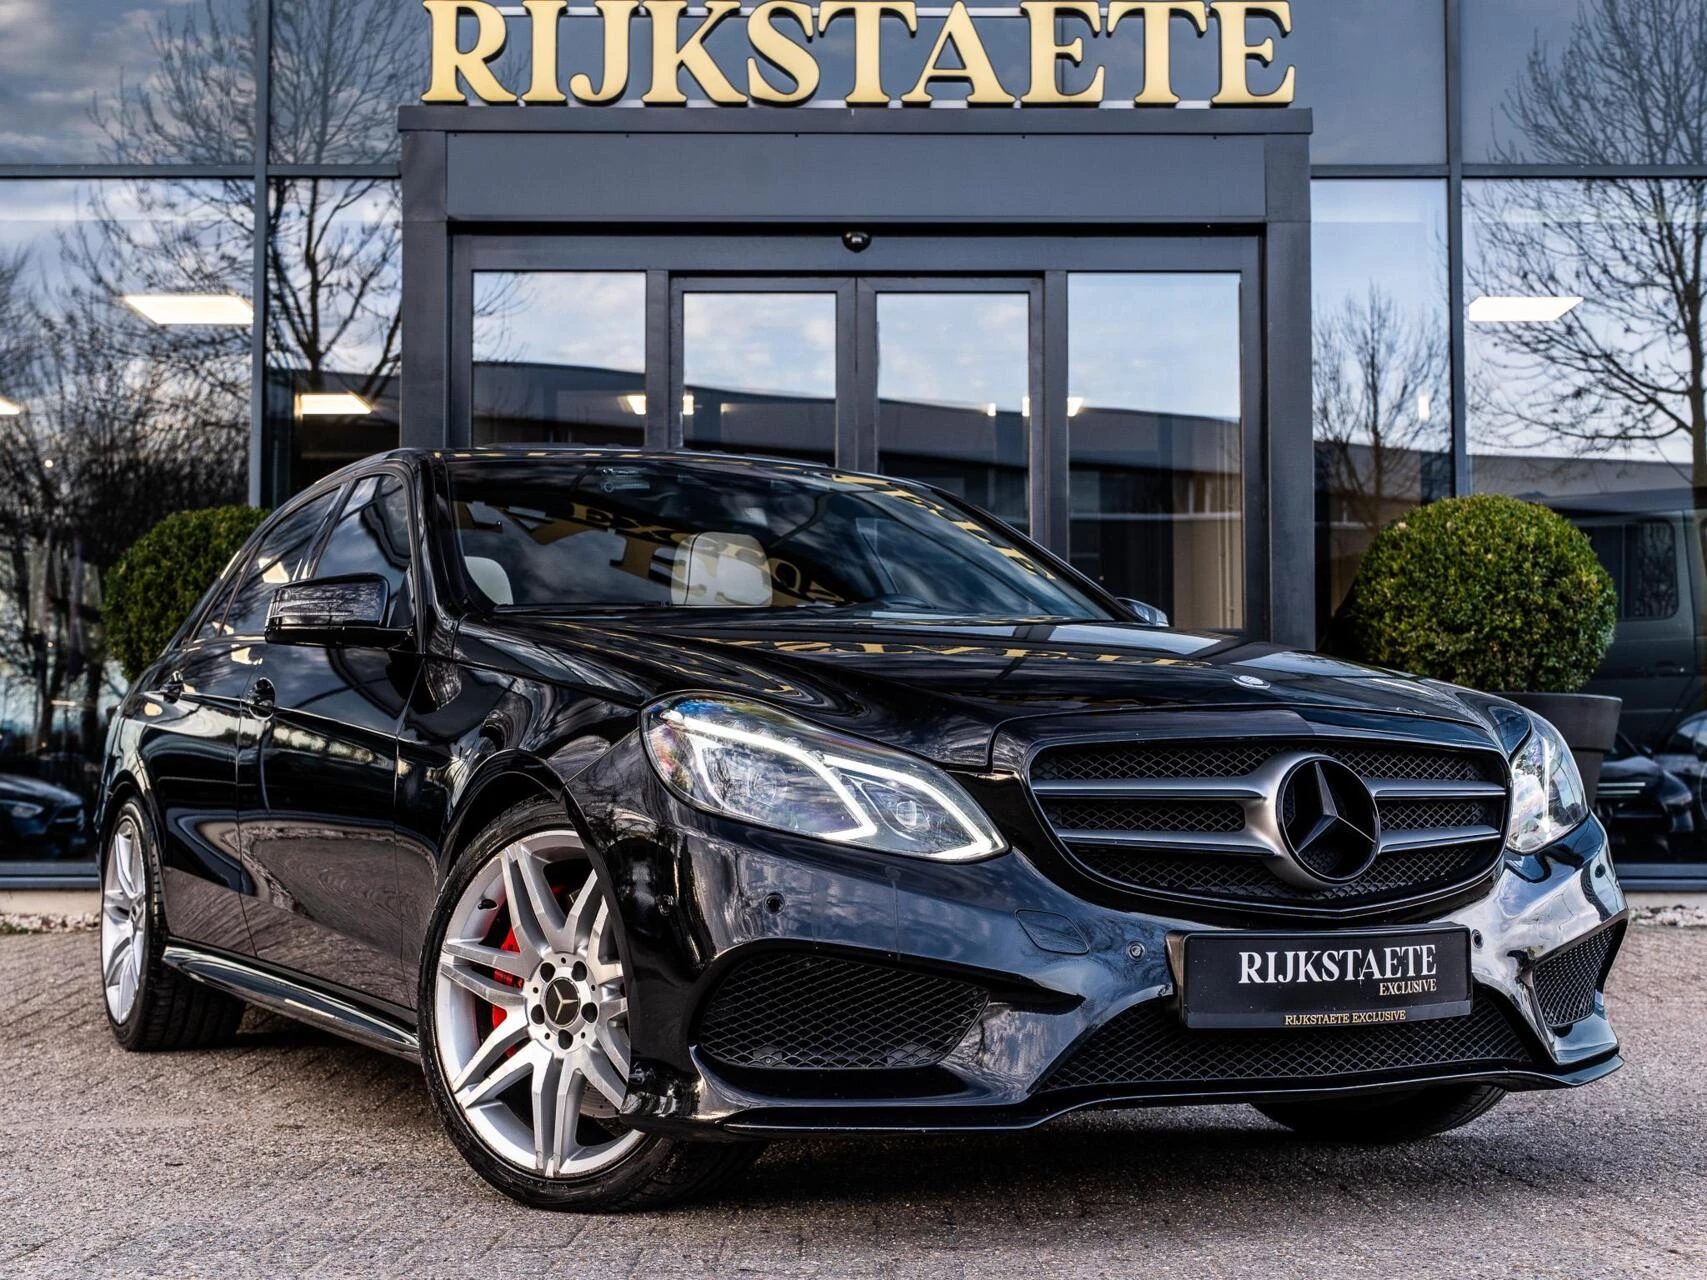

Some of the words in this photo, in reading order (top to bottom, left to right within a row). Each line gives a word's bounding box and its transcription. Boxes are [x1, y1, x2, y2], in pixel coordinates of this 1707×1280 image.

[421, 0, 1296, 106] RIJKSTAETE
[1238, 944, 1437, 984] RIJKSTAETE
[1379, 979, 1437, 996] EXCLUSIVE
[1285, 1014, 1350, 1026] RIJKSTAETE
[1351, 1011, 1406, 1023] EXCLUSIVE
